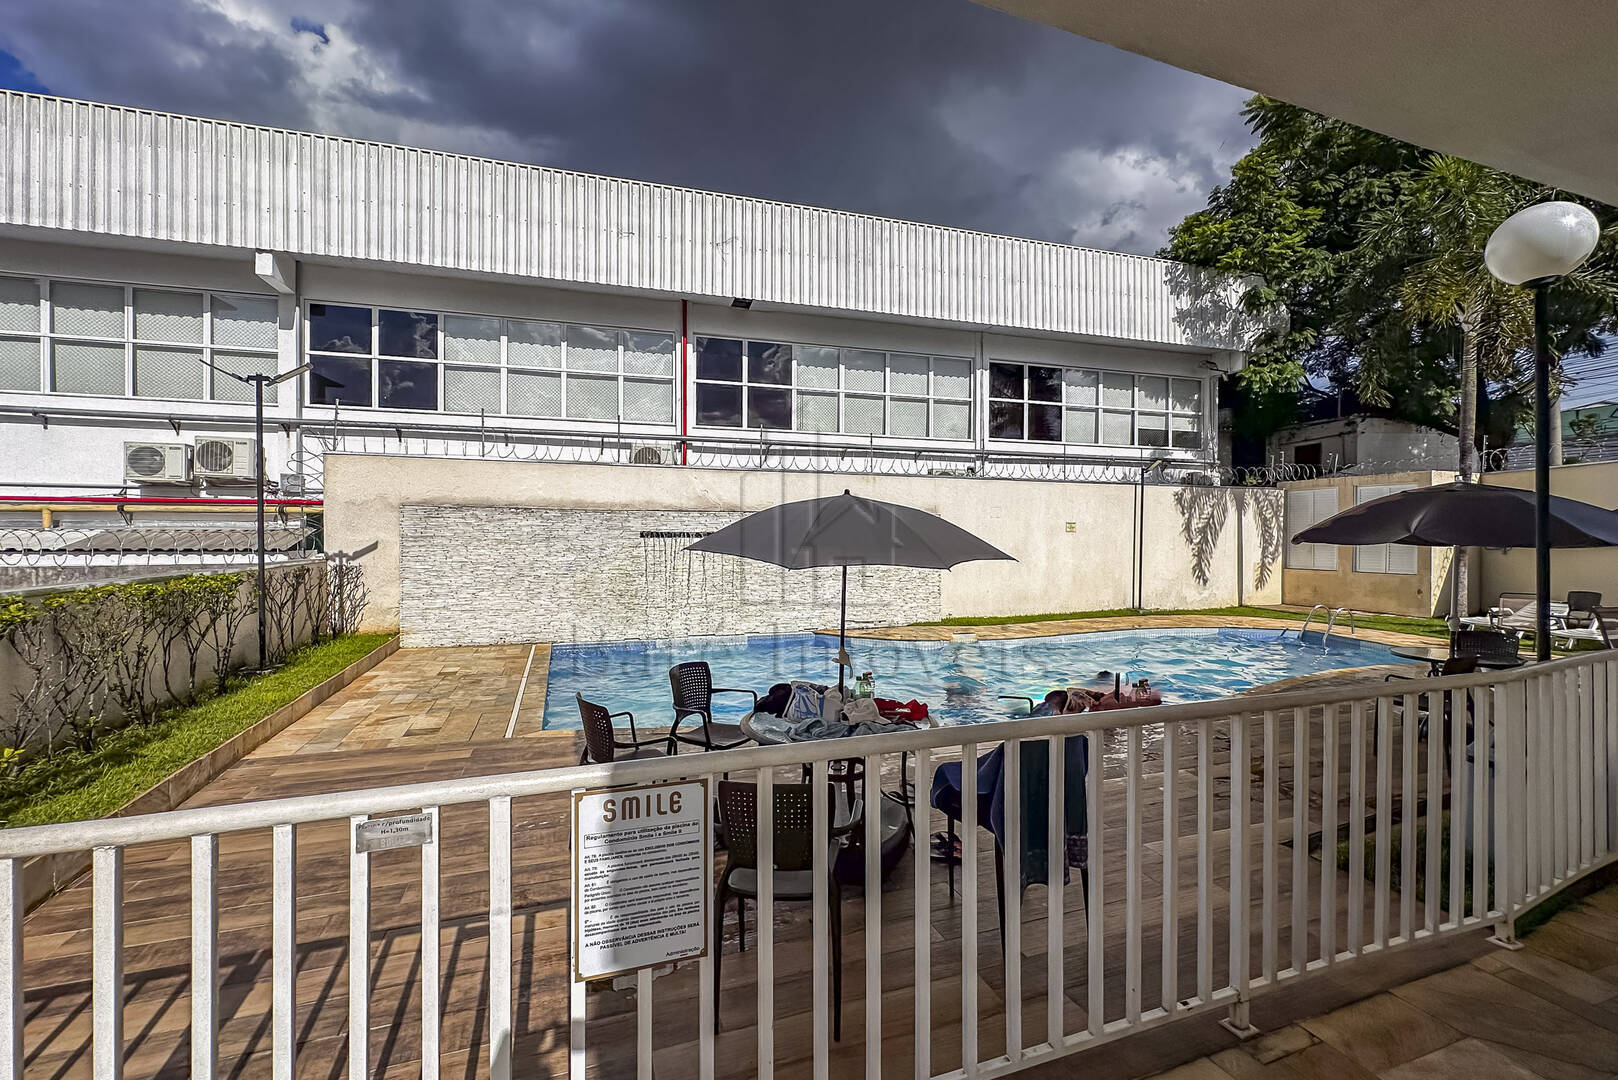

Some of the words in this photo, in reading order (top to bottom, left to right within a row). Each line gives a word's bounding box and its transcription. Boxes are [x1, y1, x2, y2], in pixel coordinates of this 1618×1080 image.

[603, 791, 682, 823] SMILE
[586, 831, 623, 841] Regulamento
[637, 825, 663, 834] utilização
[671, 822, 690, 830] piscina
[604, 836, 638, 844] Condomínio
[639, 831, 654, 839] Smile
[657, 924, 687, 934] INSTRUÇÕES
[687, 921, 700, 929] SERÁ
[600, 941, 623, 949] PASSÍVEL
[631, 933, 665, 944] ADVERTÊNCIA
